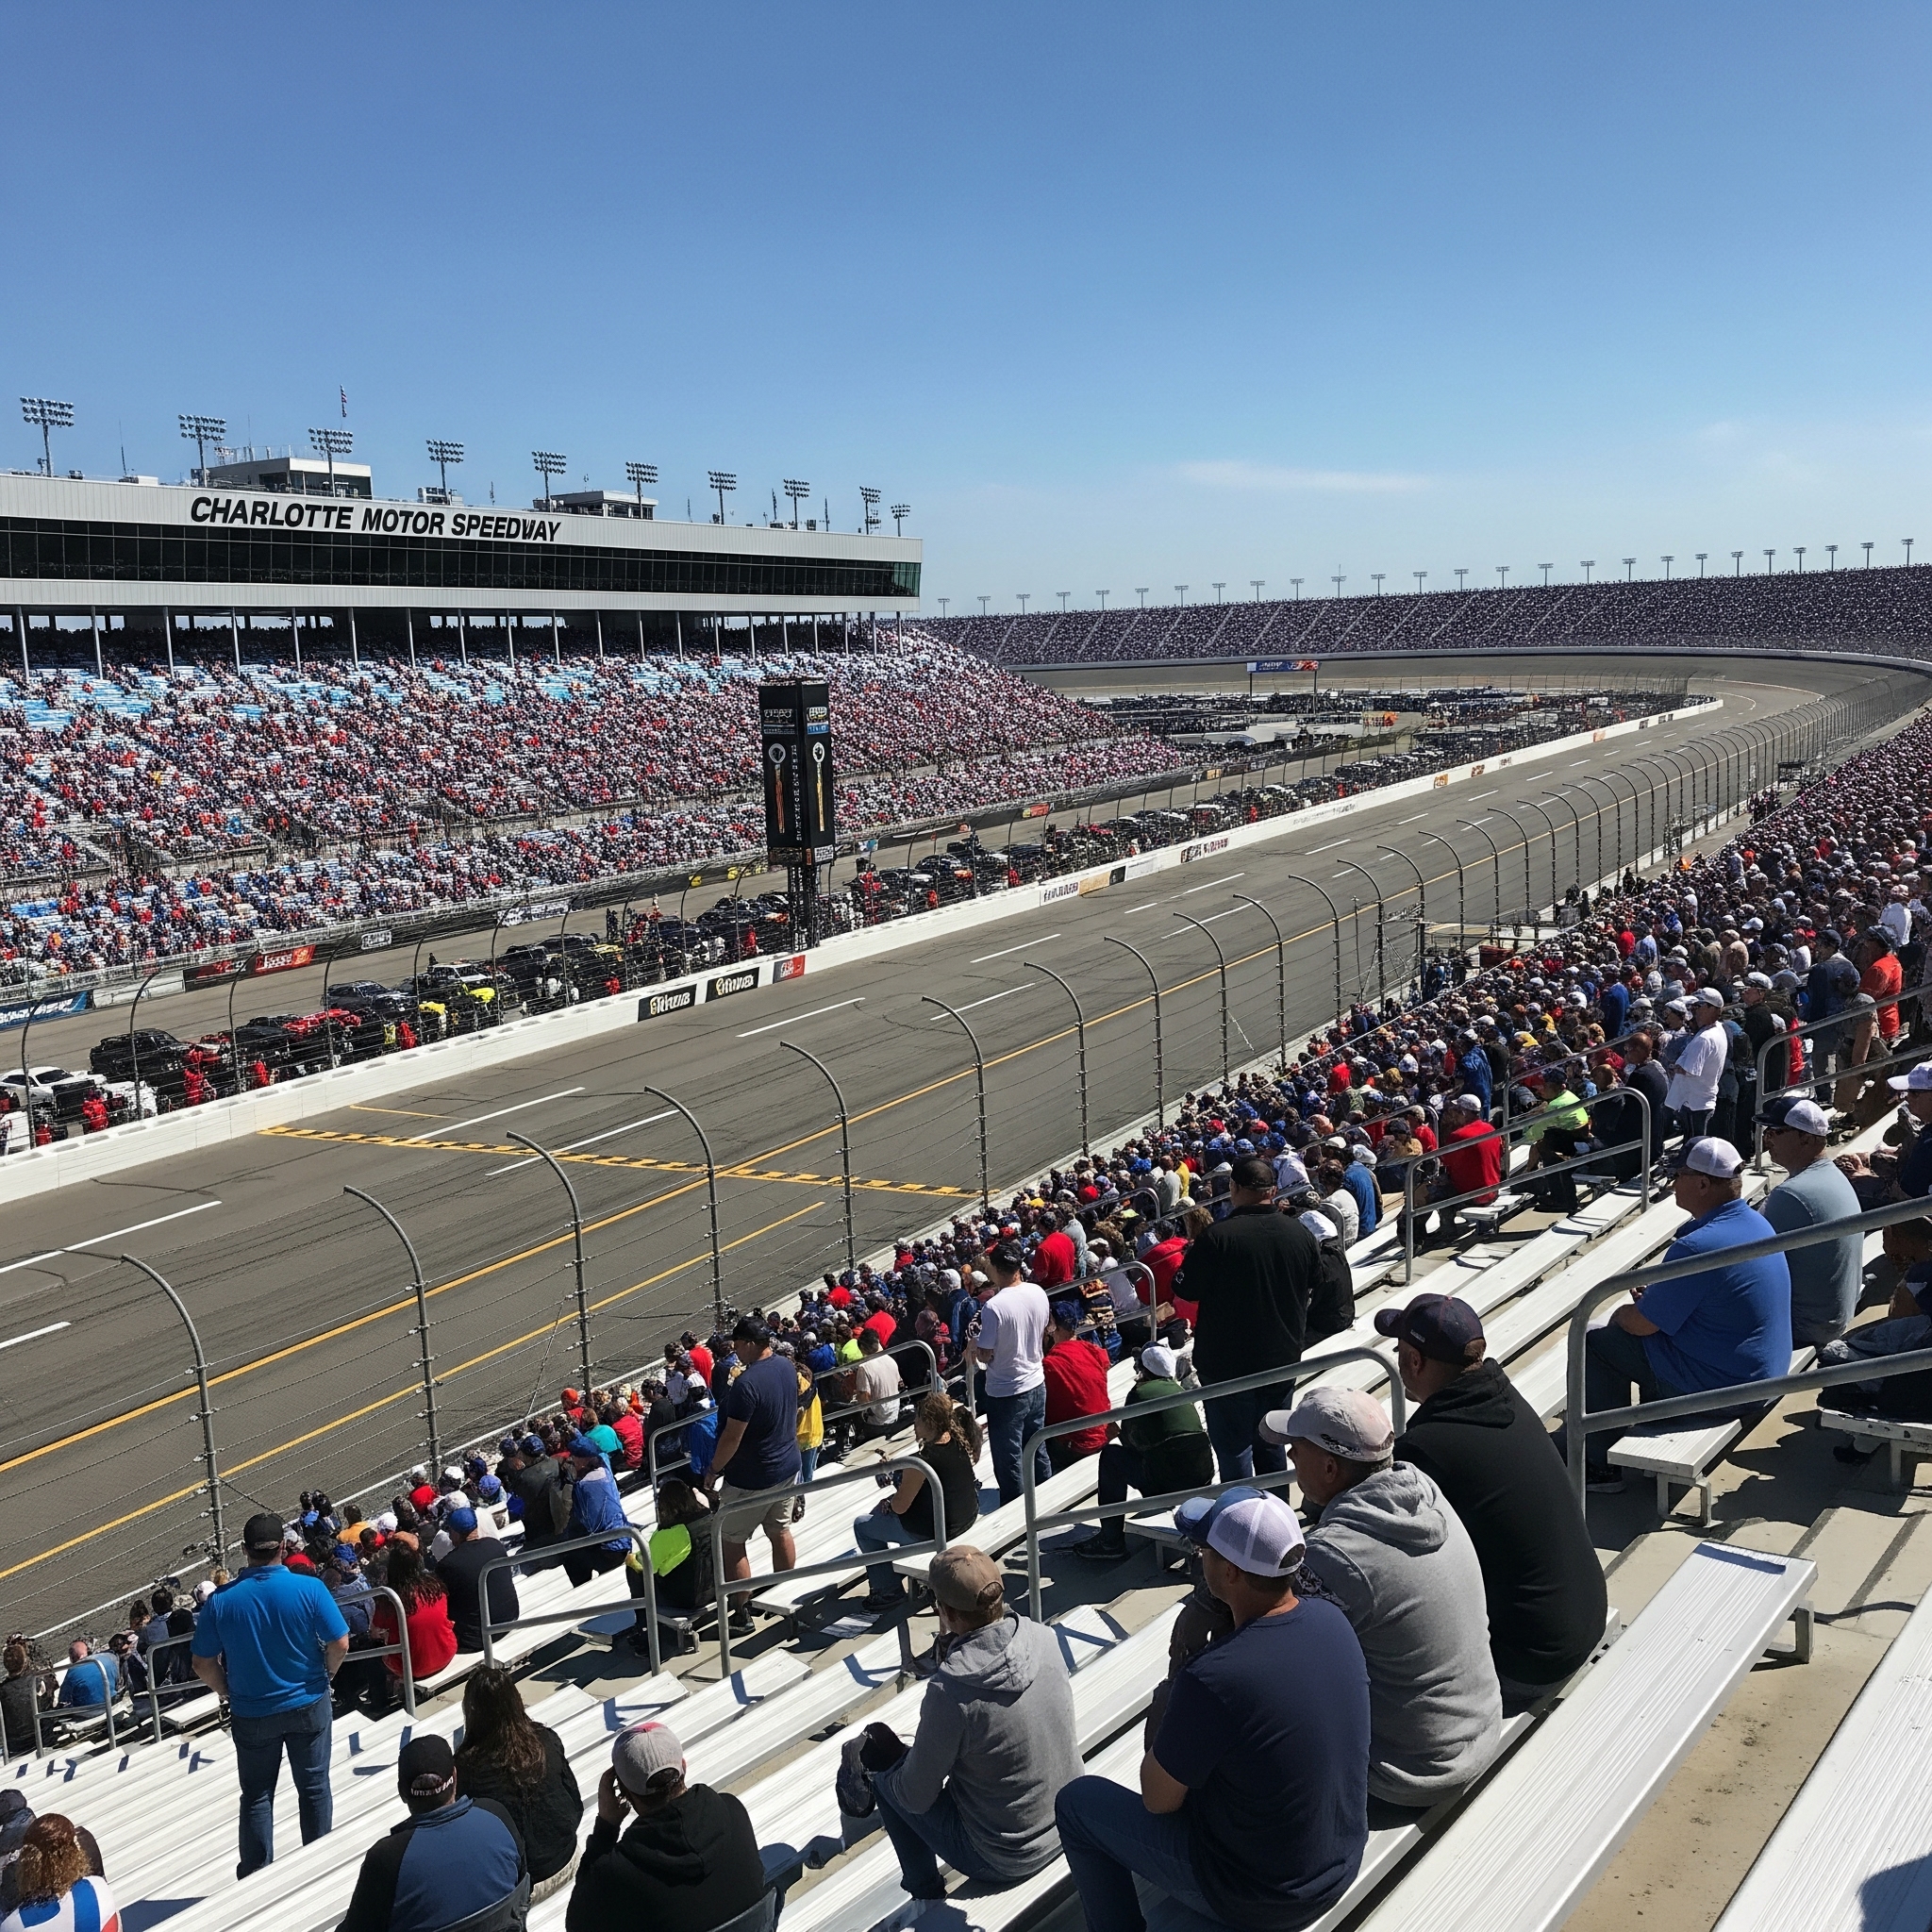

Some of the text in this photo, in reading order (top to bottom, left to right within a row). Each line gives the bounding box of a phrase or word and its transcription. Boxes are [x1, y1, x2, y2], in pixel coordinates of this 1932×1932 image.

[191, 496, 561, 541] CHARLOTTE MOTOR SPEEDWAY
